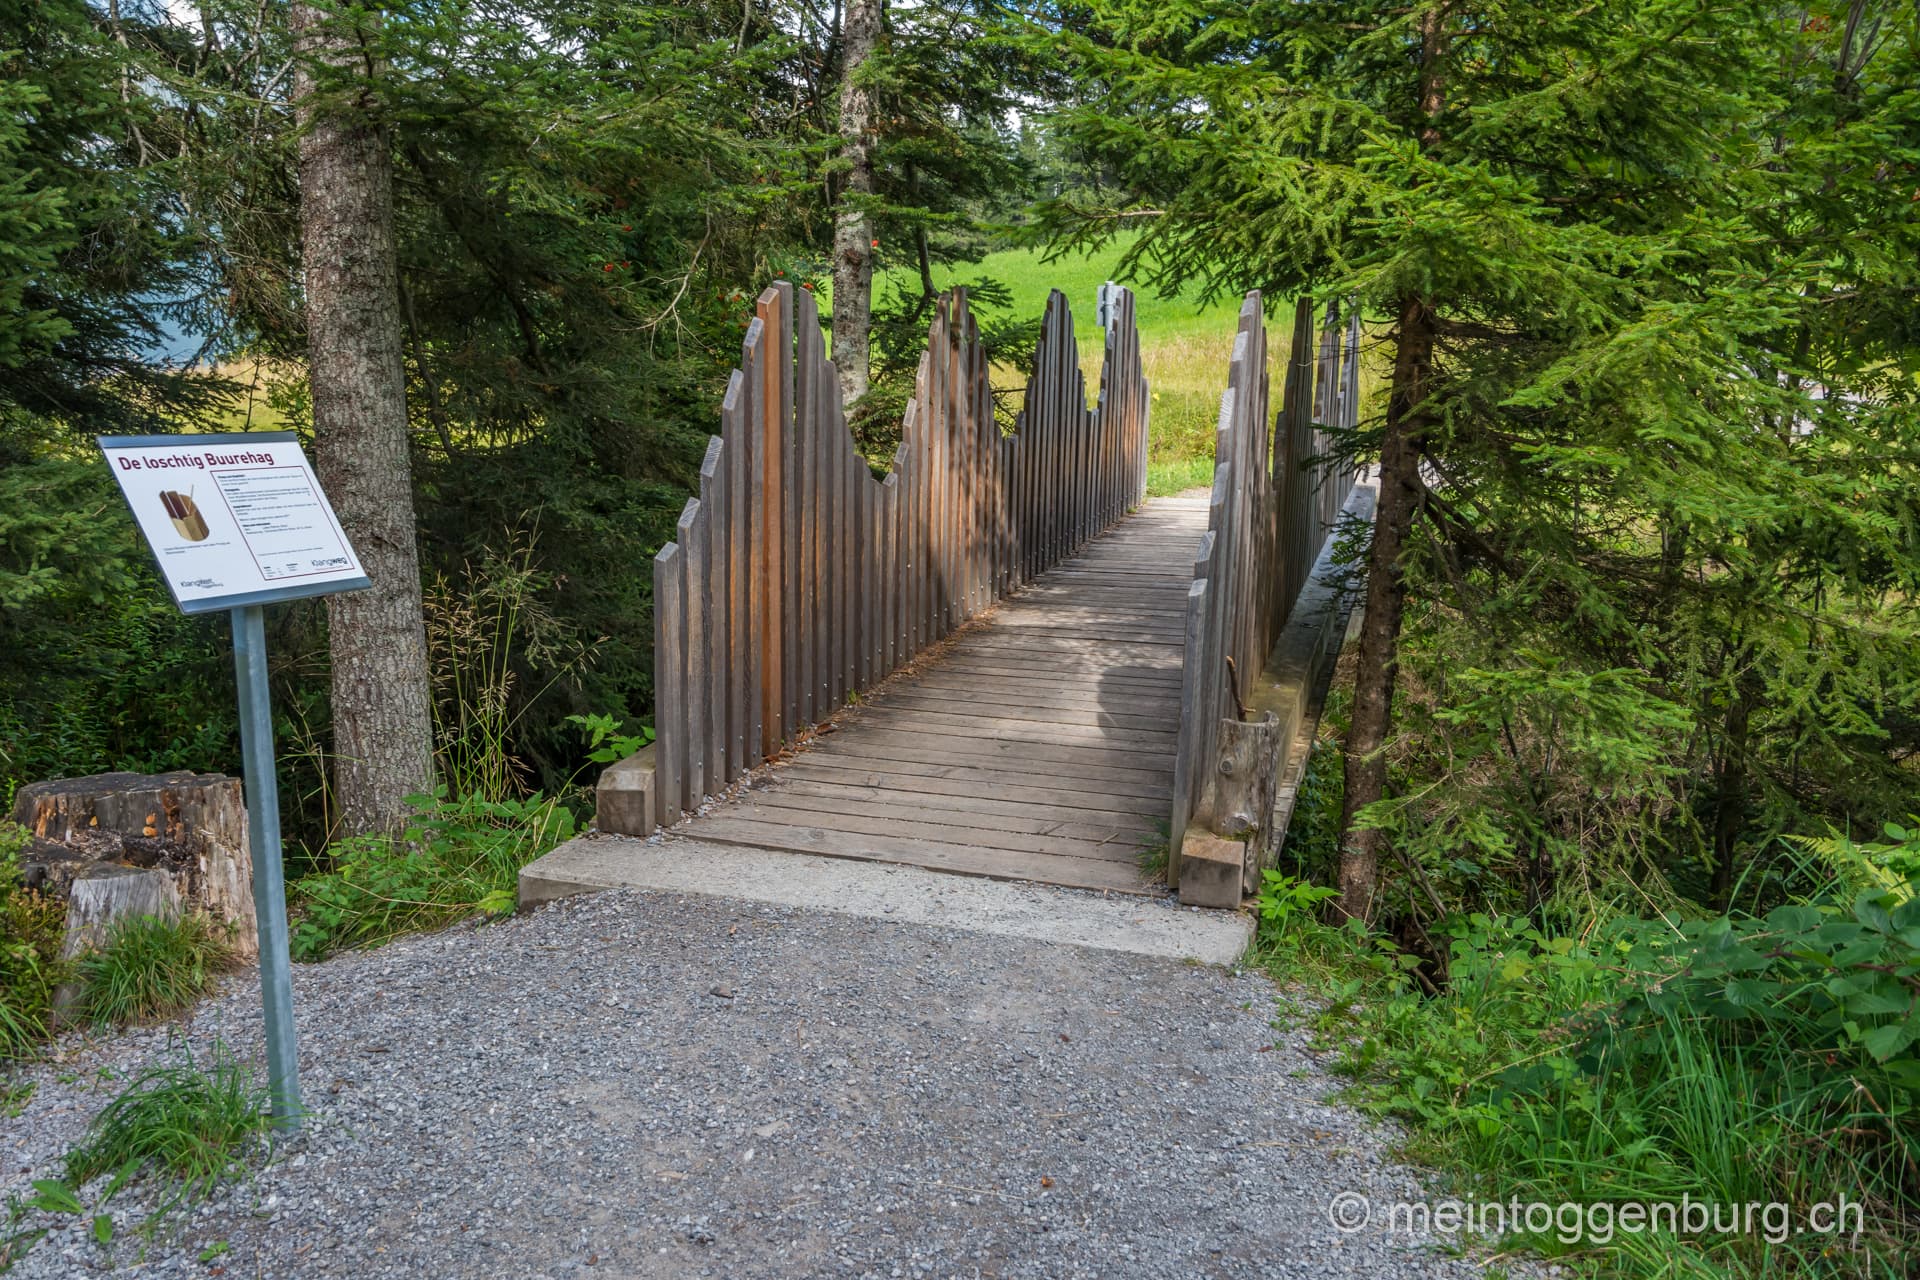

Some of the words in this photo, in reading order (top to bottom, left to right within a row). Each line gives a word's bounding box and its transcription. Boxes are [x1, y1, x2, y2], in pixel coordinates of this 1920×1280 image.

[118, 457, 142, 471] De
[142, 454, 205, 470] loschtig
[204, 451, 275, 466] Buurehag
